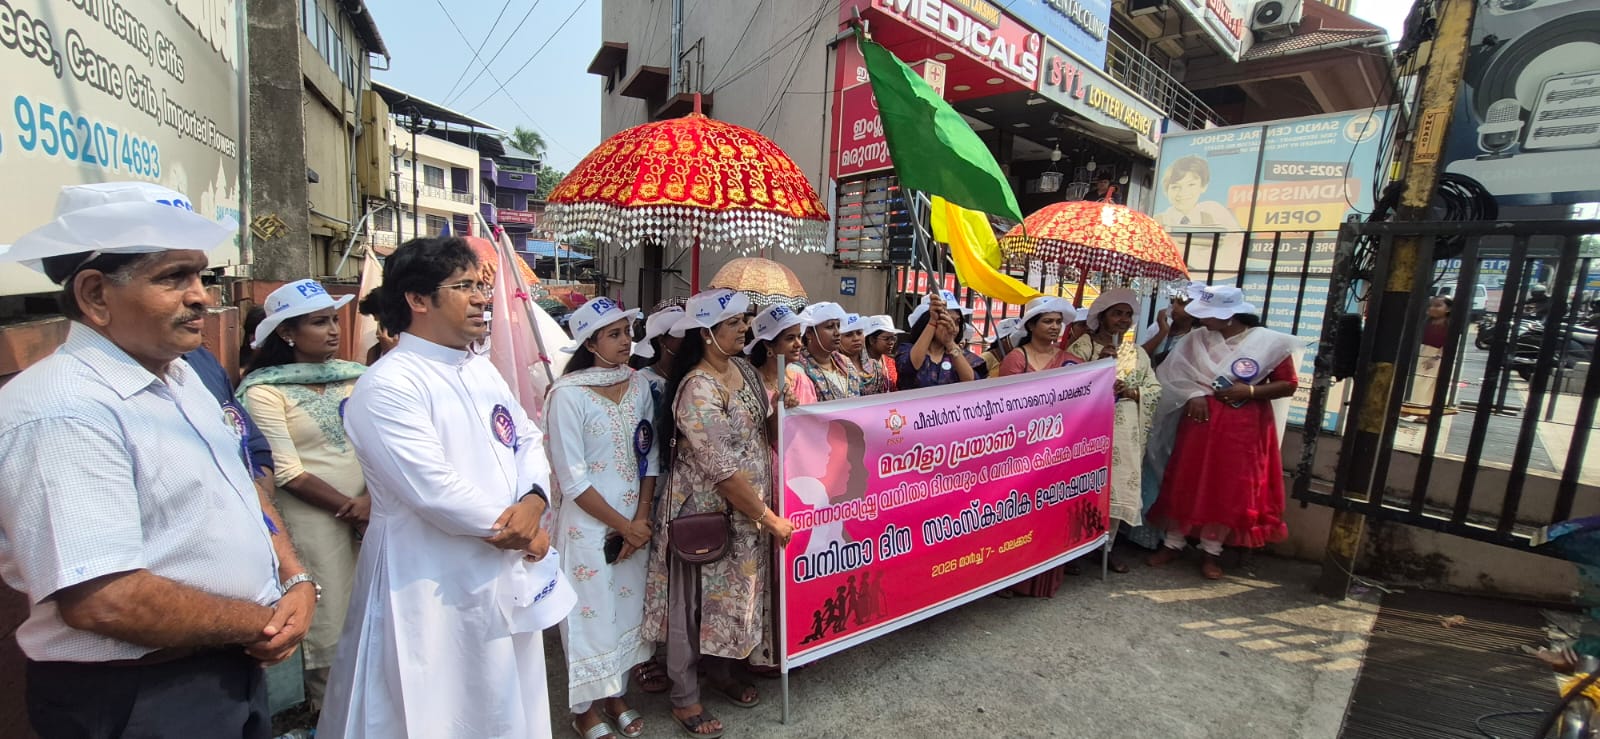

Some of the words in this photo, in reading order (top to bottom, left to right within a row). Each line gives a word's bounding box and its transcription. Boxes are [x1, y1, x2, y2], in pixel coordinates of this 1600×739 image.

[1083, 9, 1106, 41] CLINIC
[155, 30, 184, 83] Gifts
[65, 28, 122, 99] Cane
[125, 65, 161, 127] Crib,
[162, 88, 206, 144] Imported
[208, 116, 236, 159] Flowers
[1088, 84, 1124, 122] LOTTERY
[1124, 107, 1153, 136] AGENCY
[14, 95, 160, 178] 9562074693
[879, 443, 944, 478] മഹിളാ
[1028, 414, 1064, 445] 2026
[879, 484, 929, 512] വനിതാ
[930, 468, 977, 497] ദിനവും
[978, 466, 988, 484] &
[989, 455, 1030, 481] വനിതാ
[793, 537, 874, 584] വനിതാ
[878, 523, 912, 562] ദിന
[931, 560, 957, 578] 2026
[998, 530, 1035, 553] പാലക്കാട്
